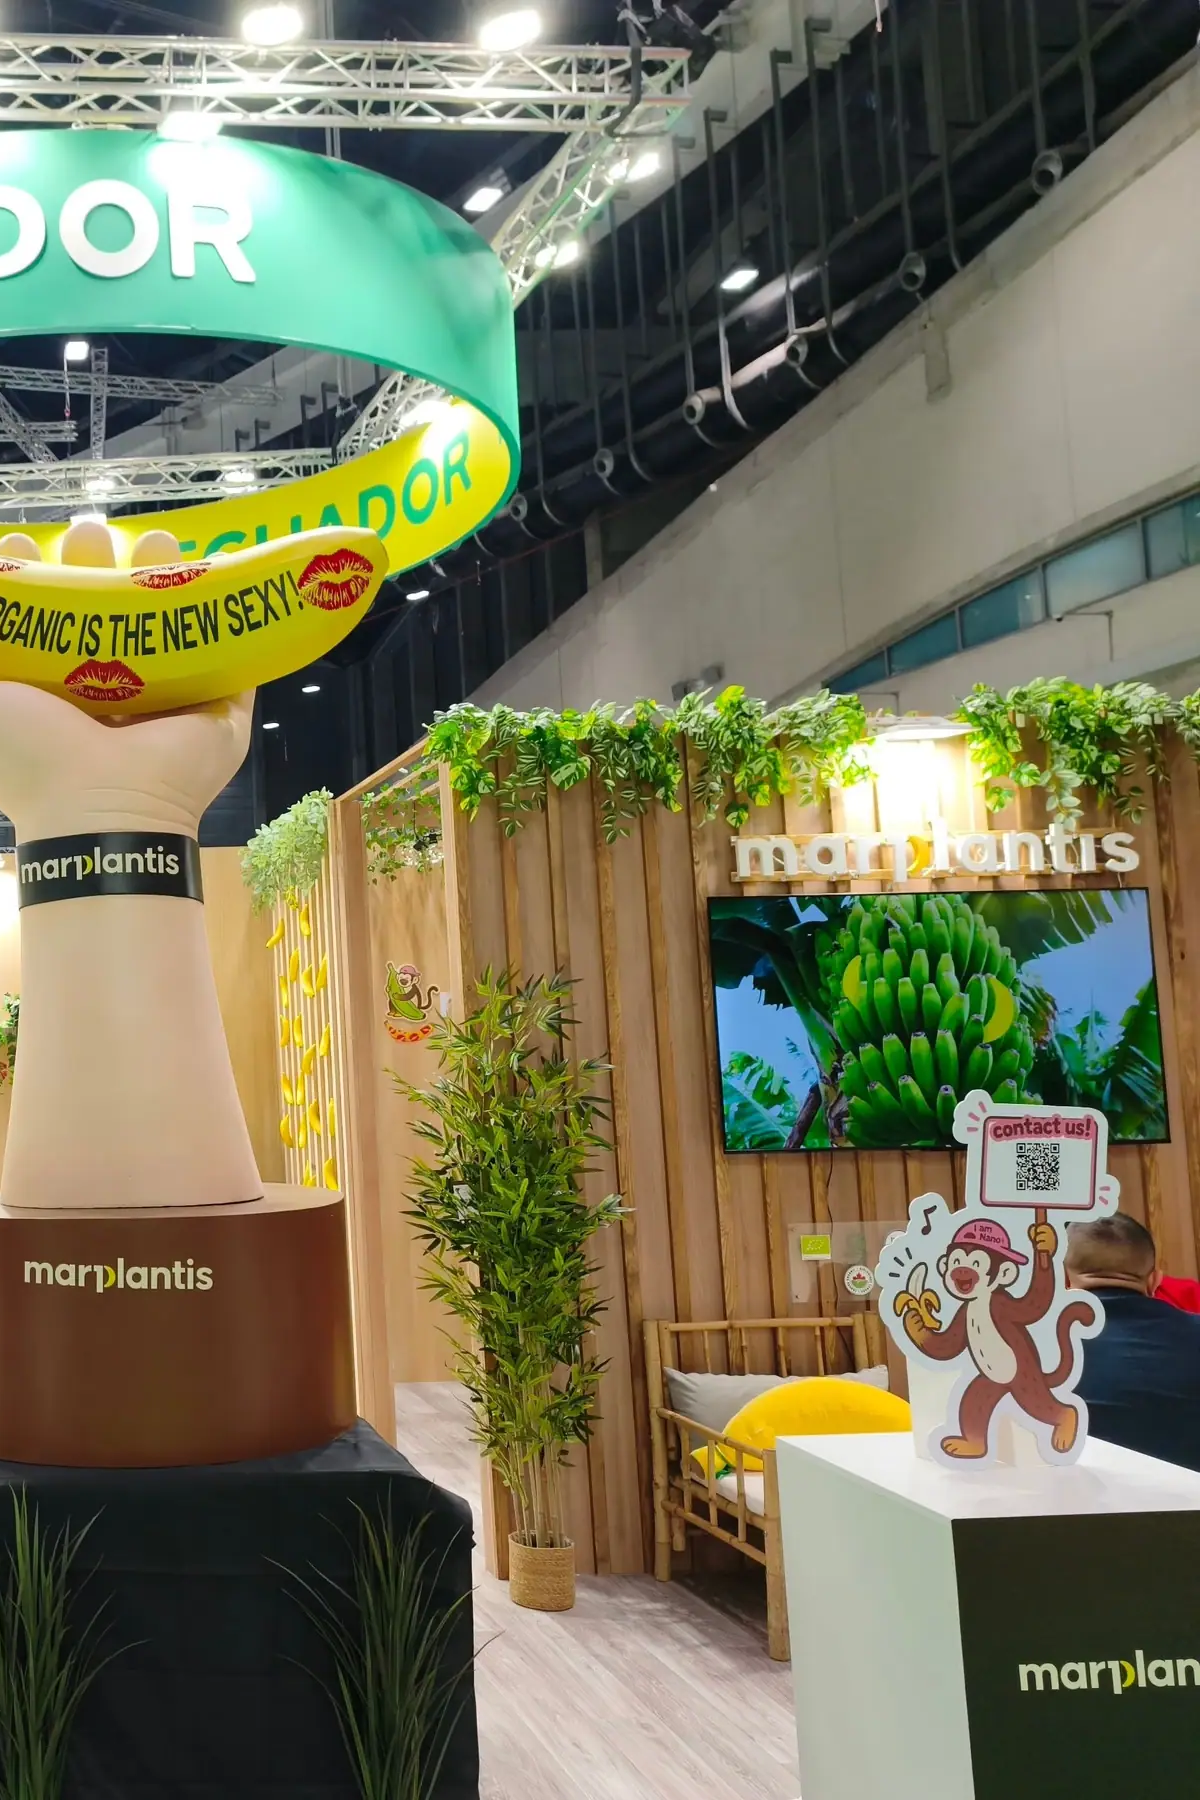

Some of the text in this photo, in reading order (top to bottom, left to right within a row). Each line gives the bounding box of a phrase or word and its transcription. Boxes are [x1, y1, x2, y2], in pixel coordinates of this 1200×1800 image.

[77, 613, 103, 657] IS
[109, 611, 156, 657] THE
[162, 599, 219, 653] NEW
[224, 570, 304, 637] SEXY!
[20, 845, 180, 884] marplantis
[735, 817, 1140, 883] marplantis
[992, 1118, 1092, 1138] contact us!
[979, 1225, 993, 1233] am
[23, 1257, 214, 1293] marplantis
[1017, 1649, 1200, 1695] marplan
